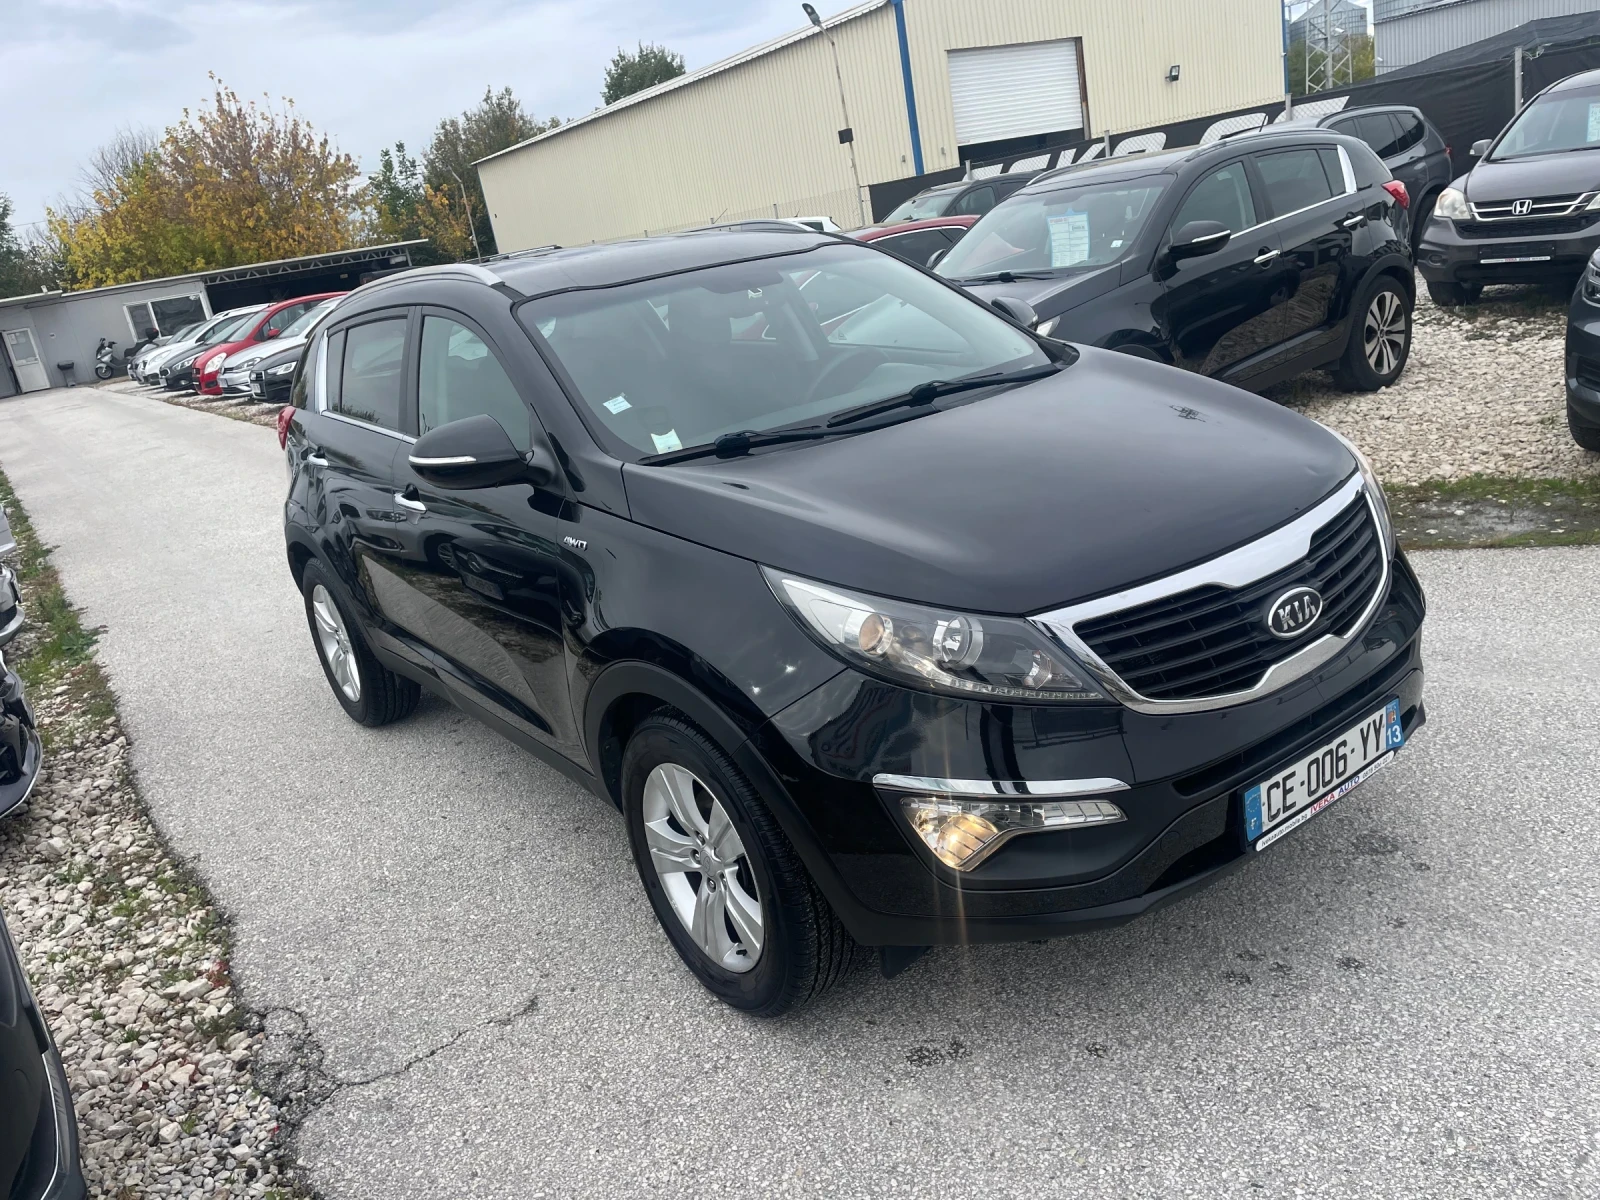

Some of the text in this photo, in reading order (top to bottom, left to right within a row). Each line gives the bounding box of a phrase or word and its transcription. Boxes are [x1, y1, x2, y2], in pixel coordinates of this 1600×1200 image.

[1277, 594, 1318, 631] KIA
[1386, 724, 1402, 745] 13
[1310, 792, 1335, 814] IVEKA
[1338, 775, 1360, 795] AUTO
